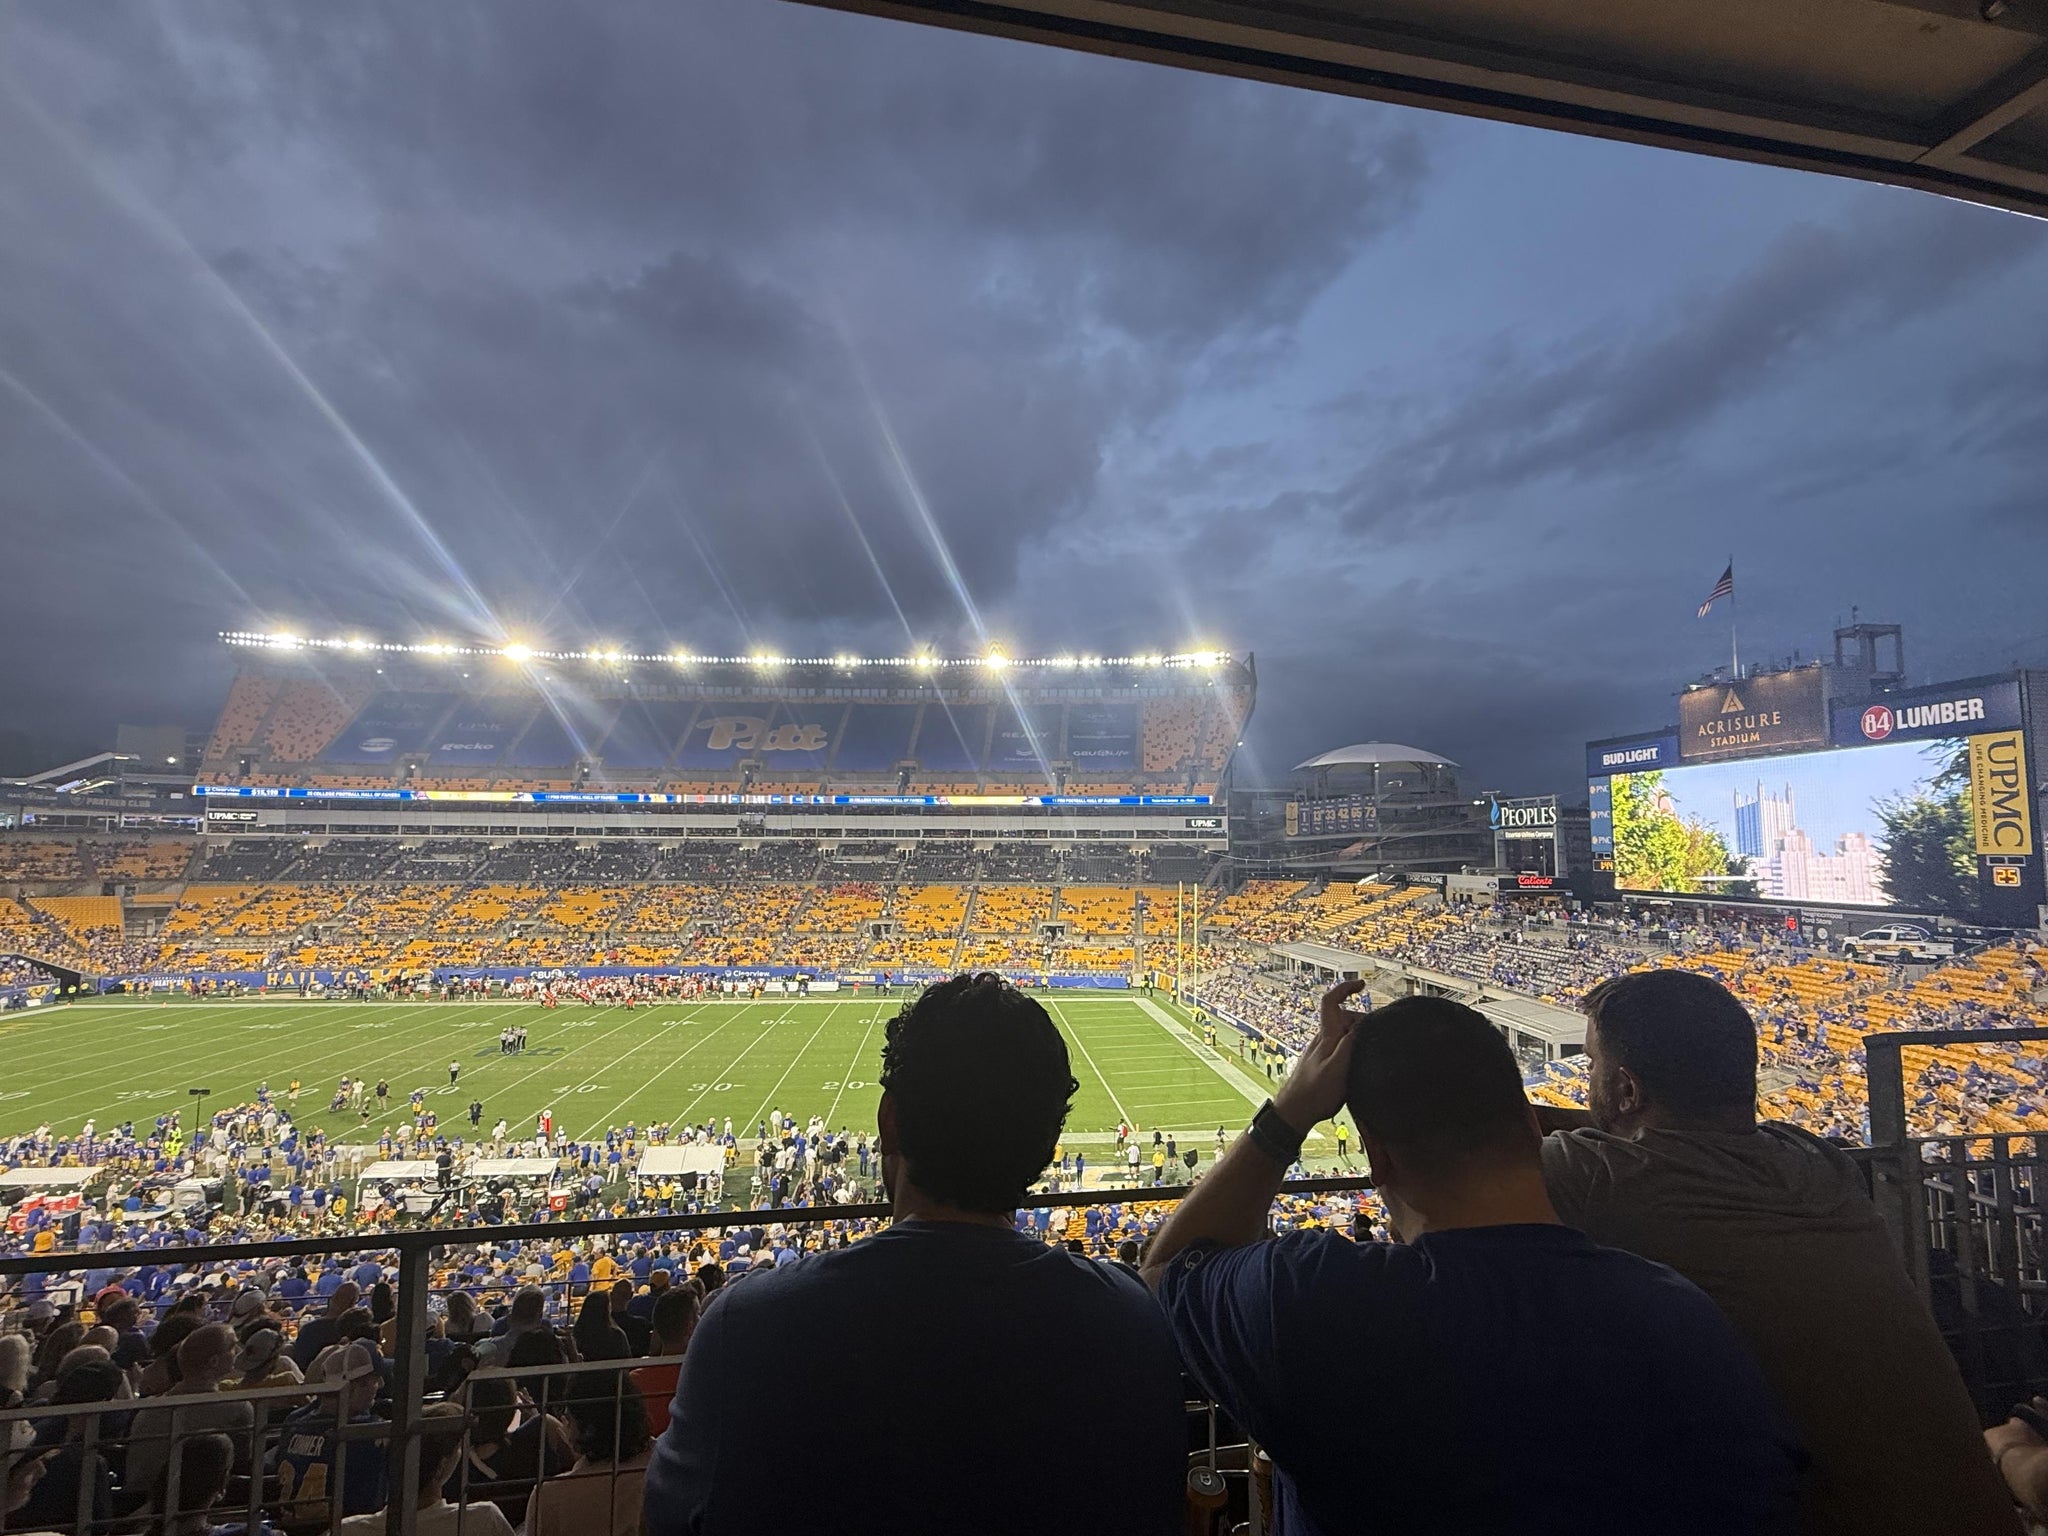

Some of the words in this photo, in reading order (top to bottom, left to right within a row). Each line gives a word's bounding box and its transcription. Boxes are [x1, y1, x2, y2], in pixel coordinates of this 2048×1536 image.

[1865, 711, 1890, 734] 84
[1896, 697, 1985, 730] LUMBER
[1698, 711, 1781, 737] ACRISURE
[1710, 731, 1760, 748] STADIUM
[440, 742, 495, 751] gecko
[1602, 752, 1625, 766] BUD
[1625, 747, 1659, 763] LIGHT
[1976, 763, 1986, 806] CHANGING
[1987, 737, 2024, 848] UPMC
[208, 812, 239, 820] UPMC
[1324, 809, 1336, 820] 33
[1337, 807, 1349, 819] 42
[1501, 806, 1557, 827] PEOPLES
[1190, 819, 1217, 828] UPMC
[1517, 874, 1553, 885] Caliente
[1997, 869, 2018, 884] 25
[266, 972, 320, 986] HAIL
[733, 969, 770, 978] Clearview
[551, 1083, 598, 1094] 40
[688, 1082, 734, 1092] 30
[821, 1081, 865, 1091] 20
